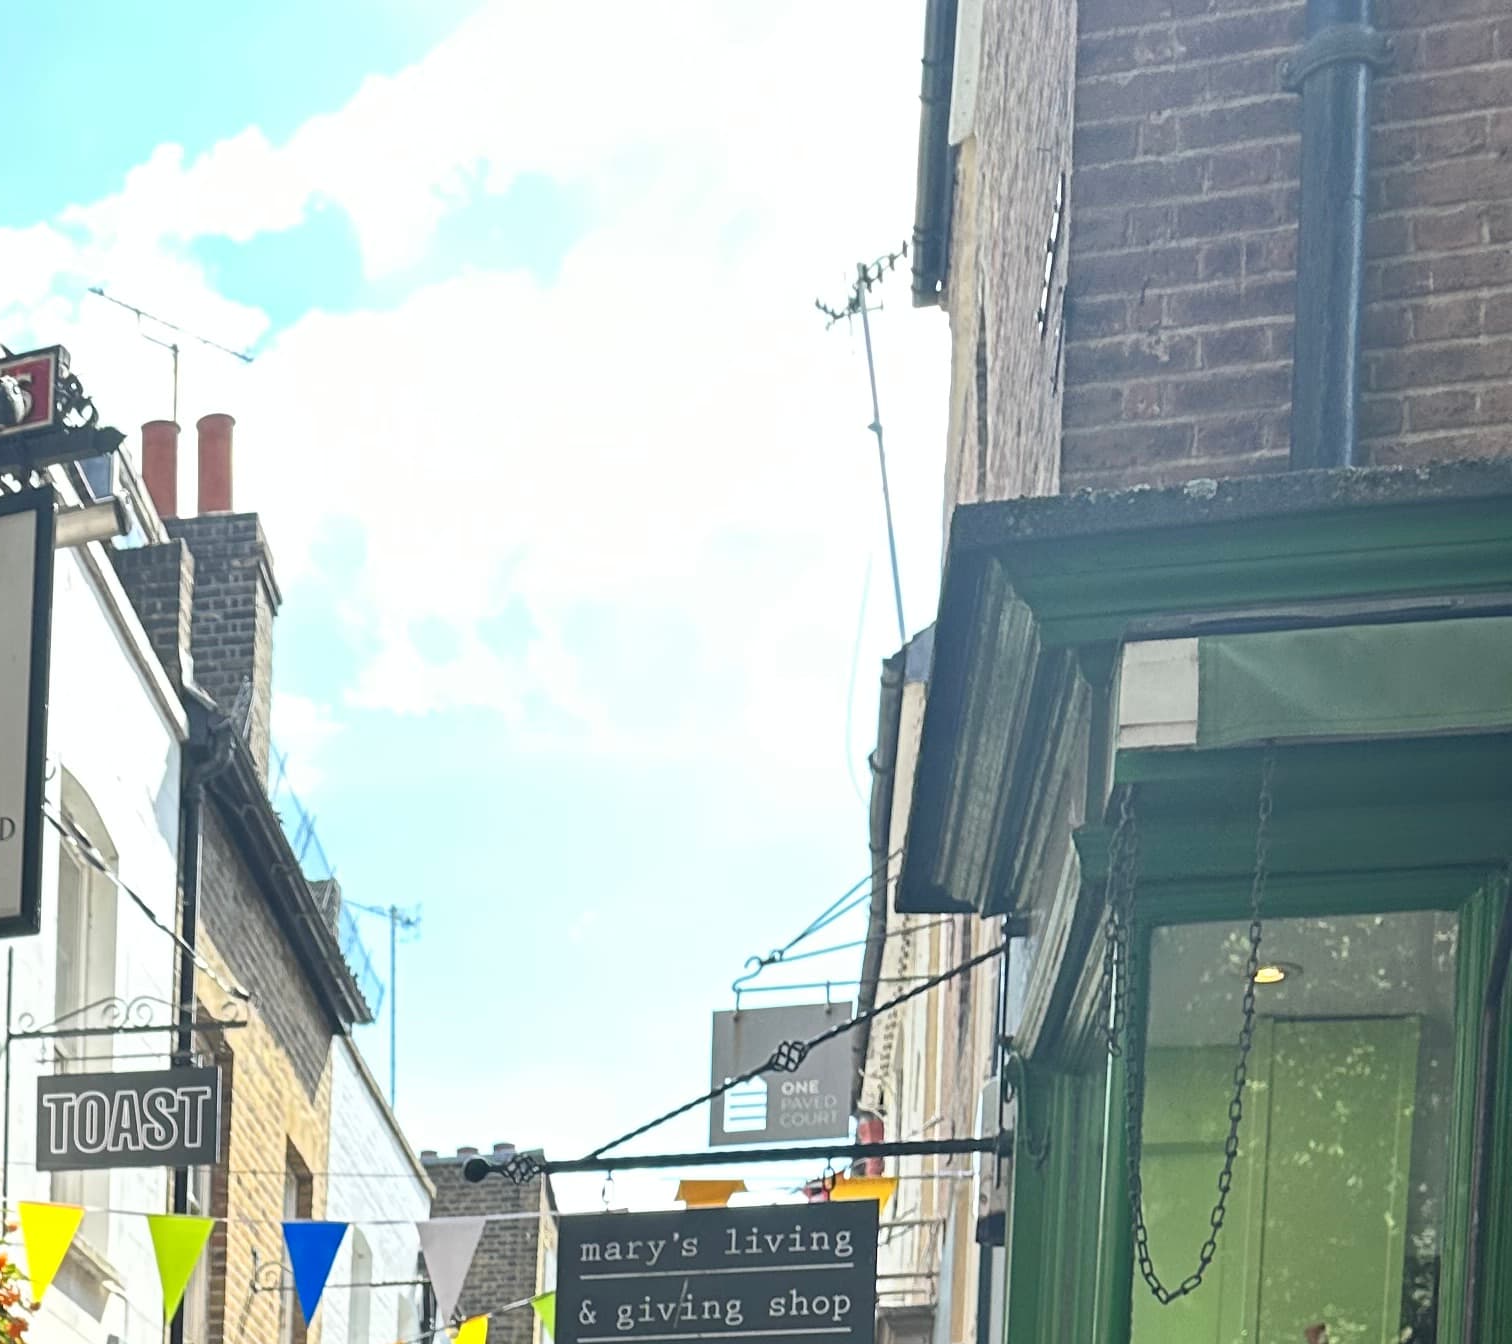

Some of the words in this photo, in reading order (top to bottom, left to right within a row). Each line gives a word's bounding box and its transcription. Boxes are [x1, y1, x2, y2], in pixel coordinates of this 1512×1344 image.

[780, 1079, 820, 1096] ONE
[780, 1095, 838, 1112] PAVED
[42, 1086, 212, 1155] TOAST
[779, 1109, 838, 1129] COURT
[579, 1231, 700, 1266] mary's
[724, 1225, 854, 1257] living
[577, 1300, 597, 1326] &
[615, 1291, 745, 1331] giving
[768, 1288, 852, 1322] shop
